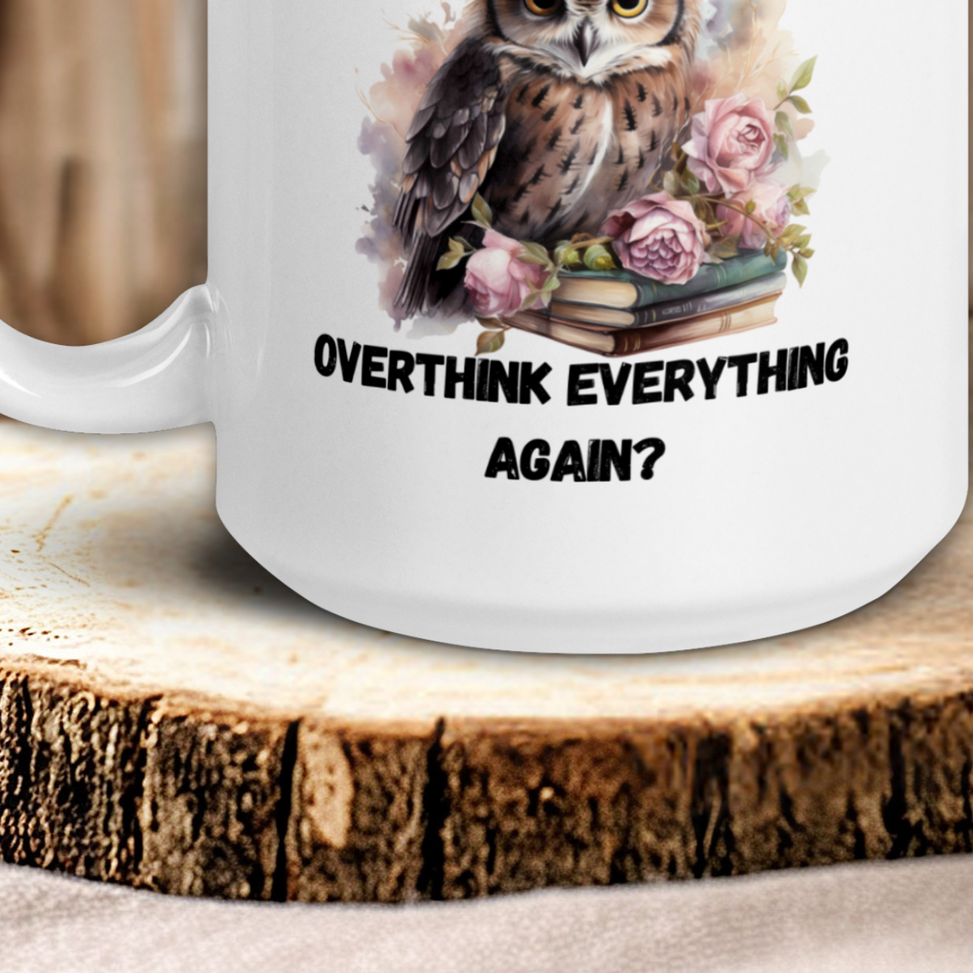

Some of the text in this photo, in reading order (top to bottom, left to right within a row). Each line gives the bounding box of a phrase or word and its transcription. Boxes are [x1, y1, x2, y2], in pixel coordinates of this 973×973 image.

[313, 333, 849, 407] OVERTHINK EVERYTHING
[484, 436, 666, 483] AGAIN?
